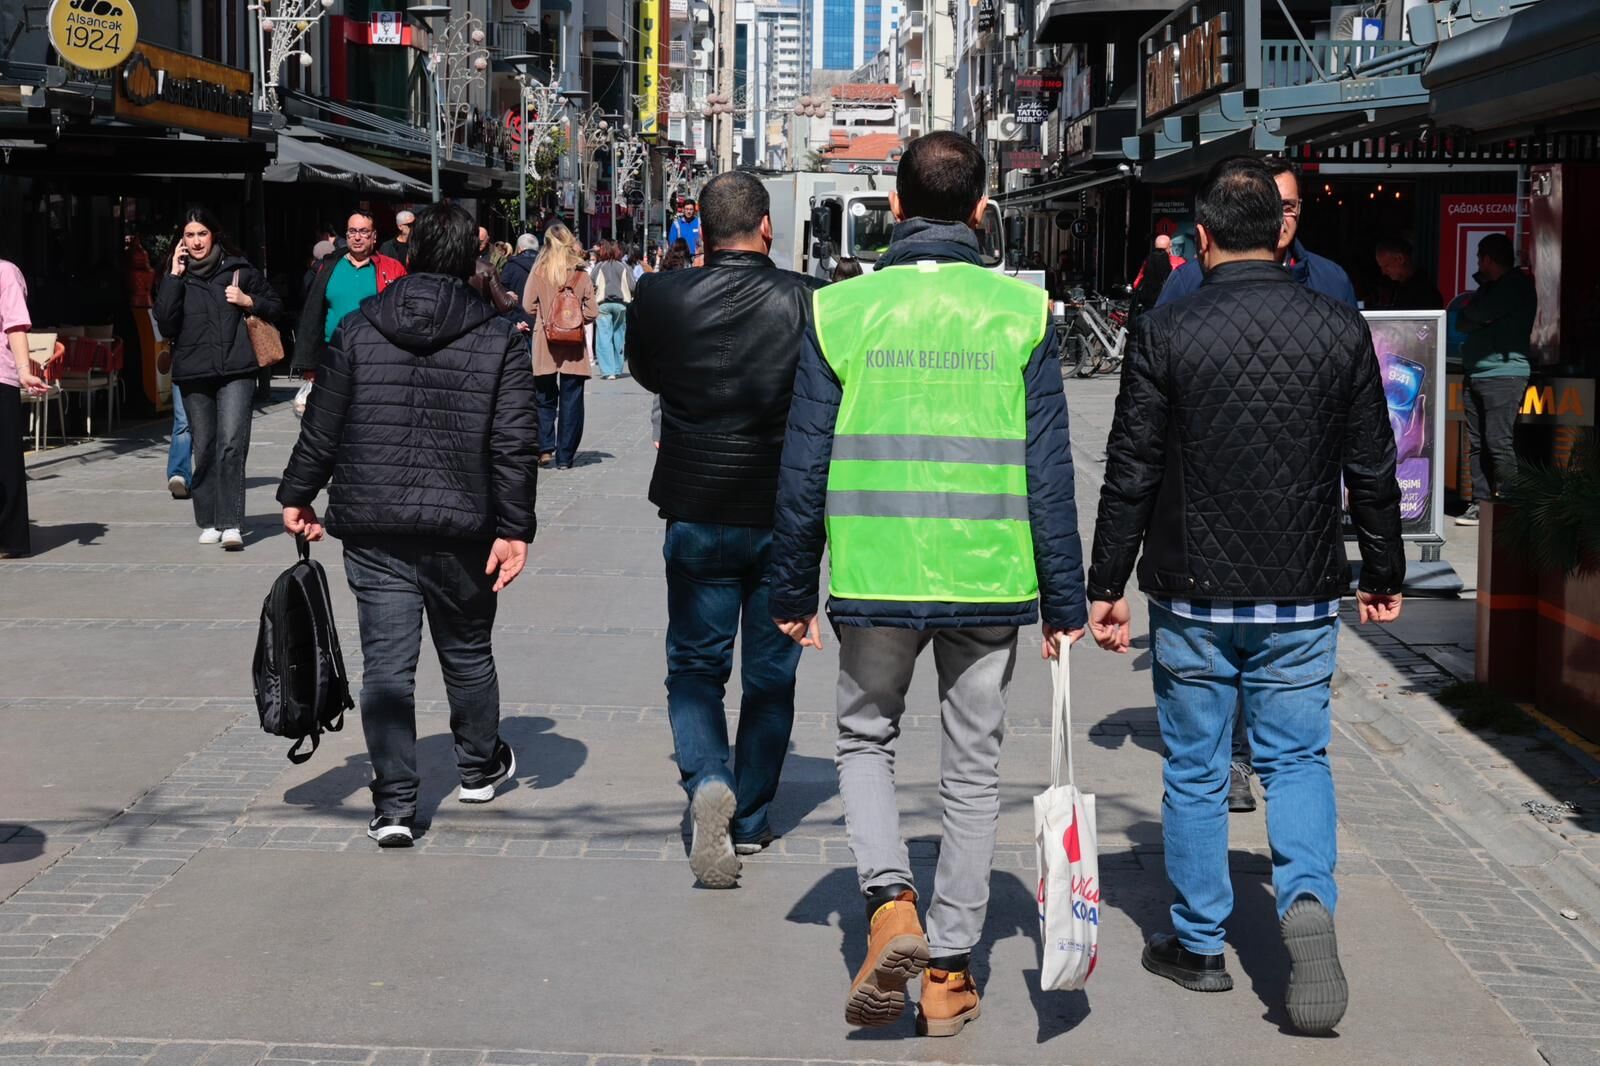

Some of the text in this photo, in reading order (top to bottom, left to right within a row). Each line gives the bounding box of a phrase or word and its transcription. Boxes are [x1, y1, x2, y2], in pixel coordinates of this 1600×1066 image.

[66, 12, 122, 31] Alsancak
[65, 25, 120, 54] 1924
[643, 0, 654, 88] URS
[1017, 109, 1049, 117] TATTOO
[1448, 202, 1528, 215] ÇAĞDAŞ ECZANİ
[866, 348, 995, 371] KONAK BELEDİYESİ
[1388, 370, 1410, 386] 9:41
